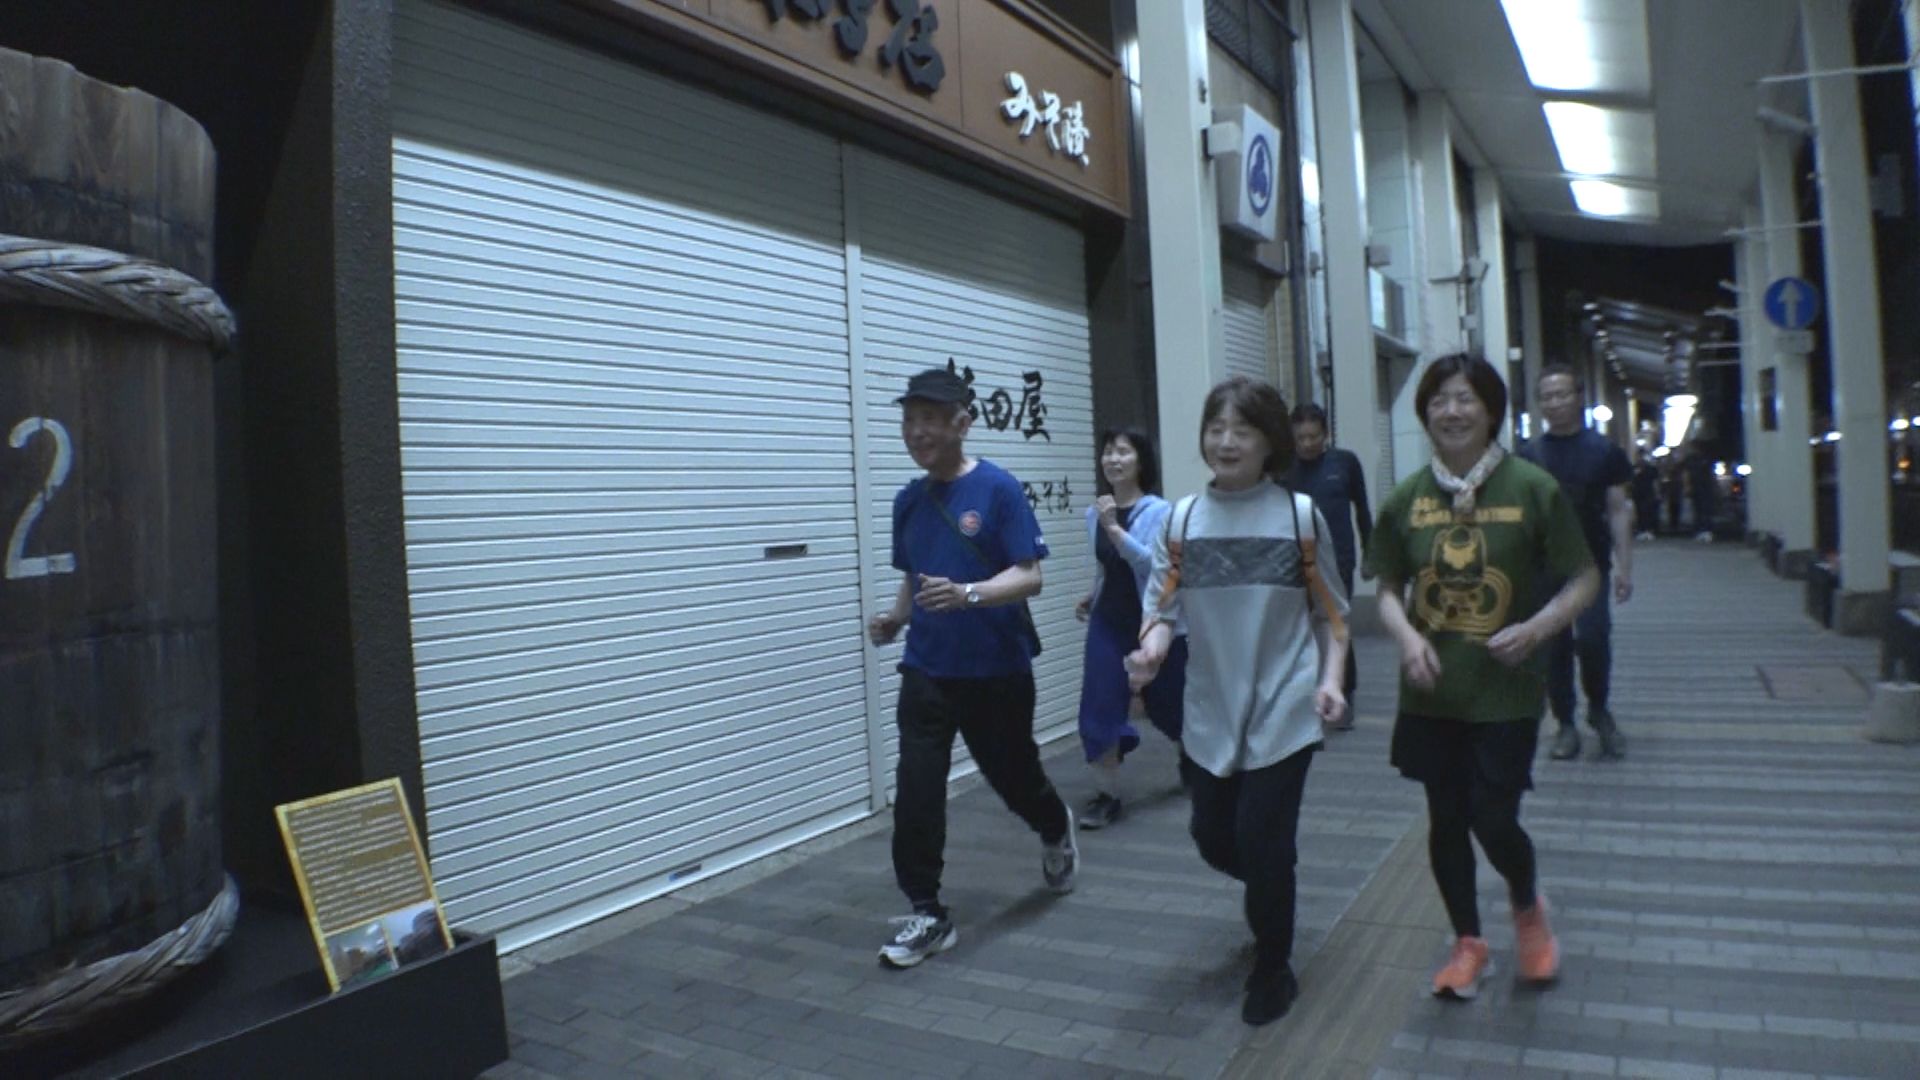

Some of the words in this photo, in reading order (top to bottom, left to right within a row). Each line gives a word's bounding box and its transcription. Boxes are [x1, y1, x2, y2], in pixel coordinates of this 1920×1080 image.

[1001, 71, 1090, 166] みそ漬
[5, 416, 76, 580] 2
